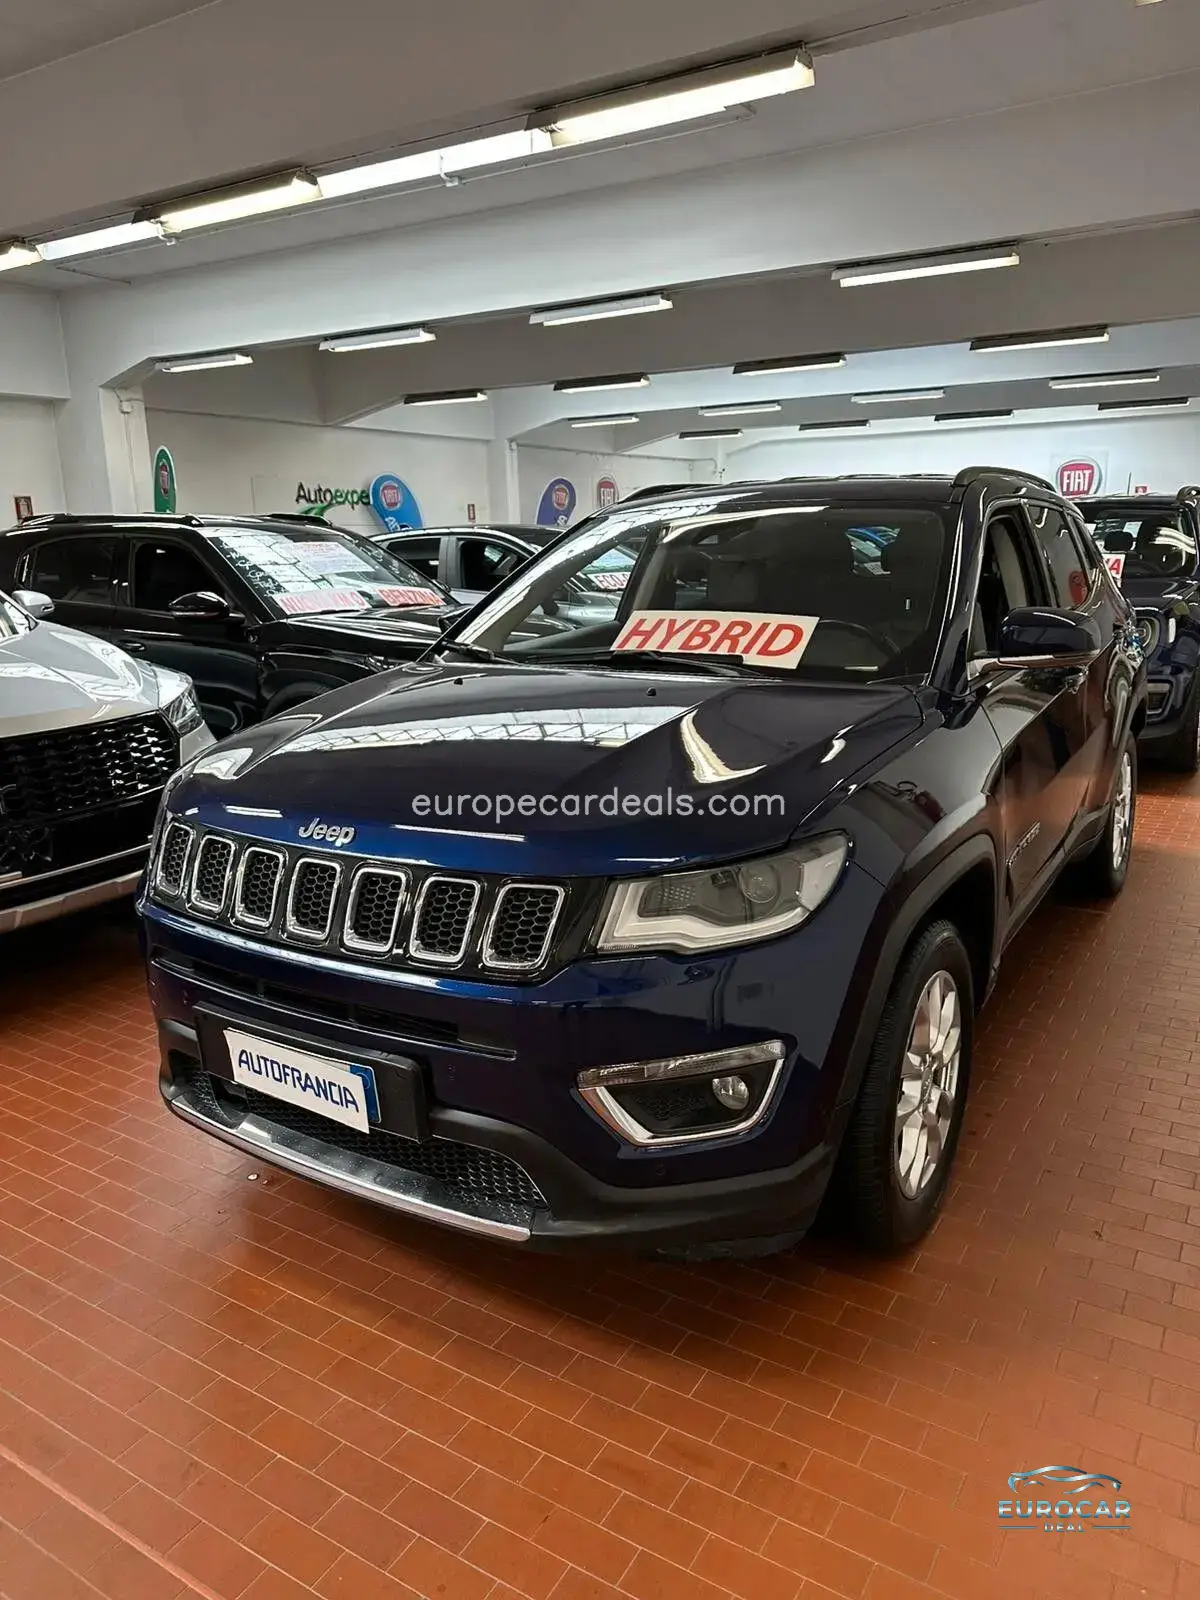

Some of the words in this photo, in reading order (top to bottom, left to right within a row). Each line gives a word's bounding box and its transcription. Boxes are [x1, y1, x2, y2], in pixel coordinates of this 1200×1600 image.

[1063, 469, 1092, 492] FIAT
[615, 616, 804, 658] HYBRID
[298, 817, 355, 847] Jeep
[238, 1049, 359, 1113] AUTOFRANCIA
